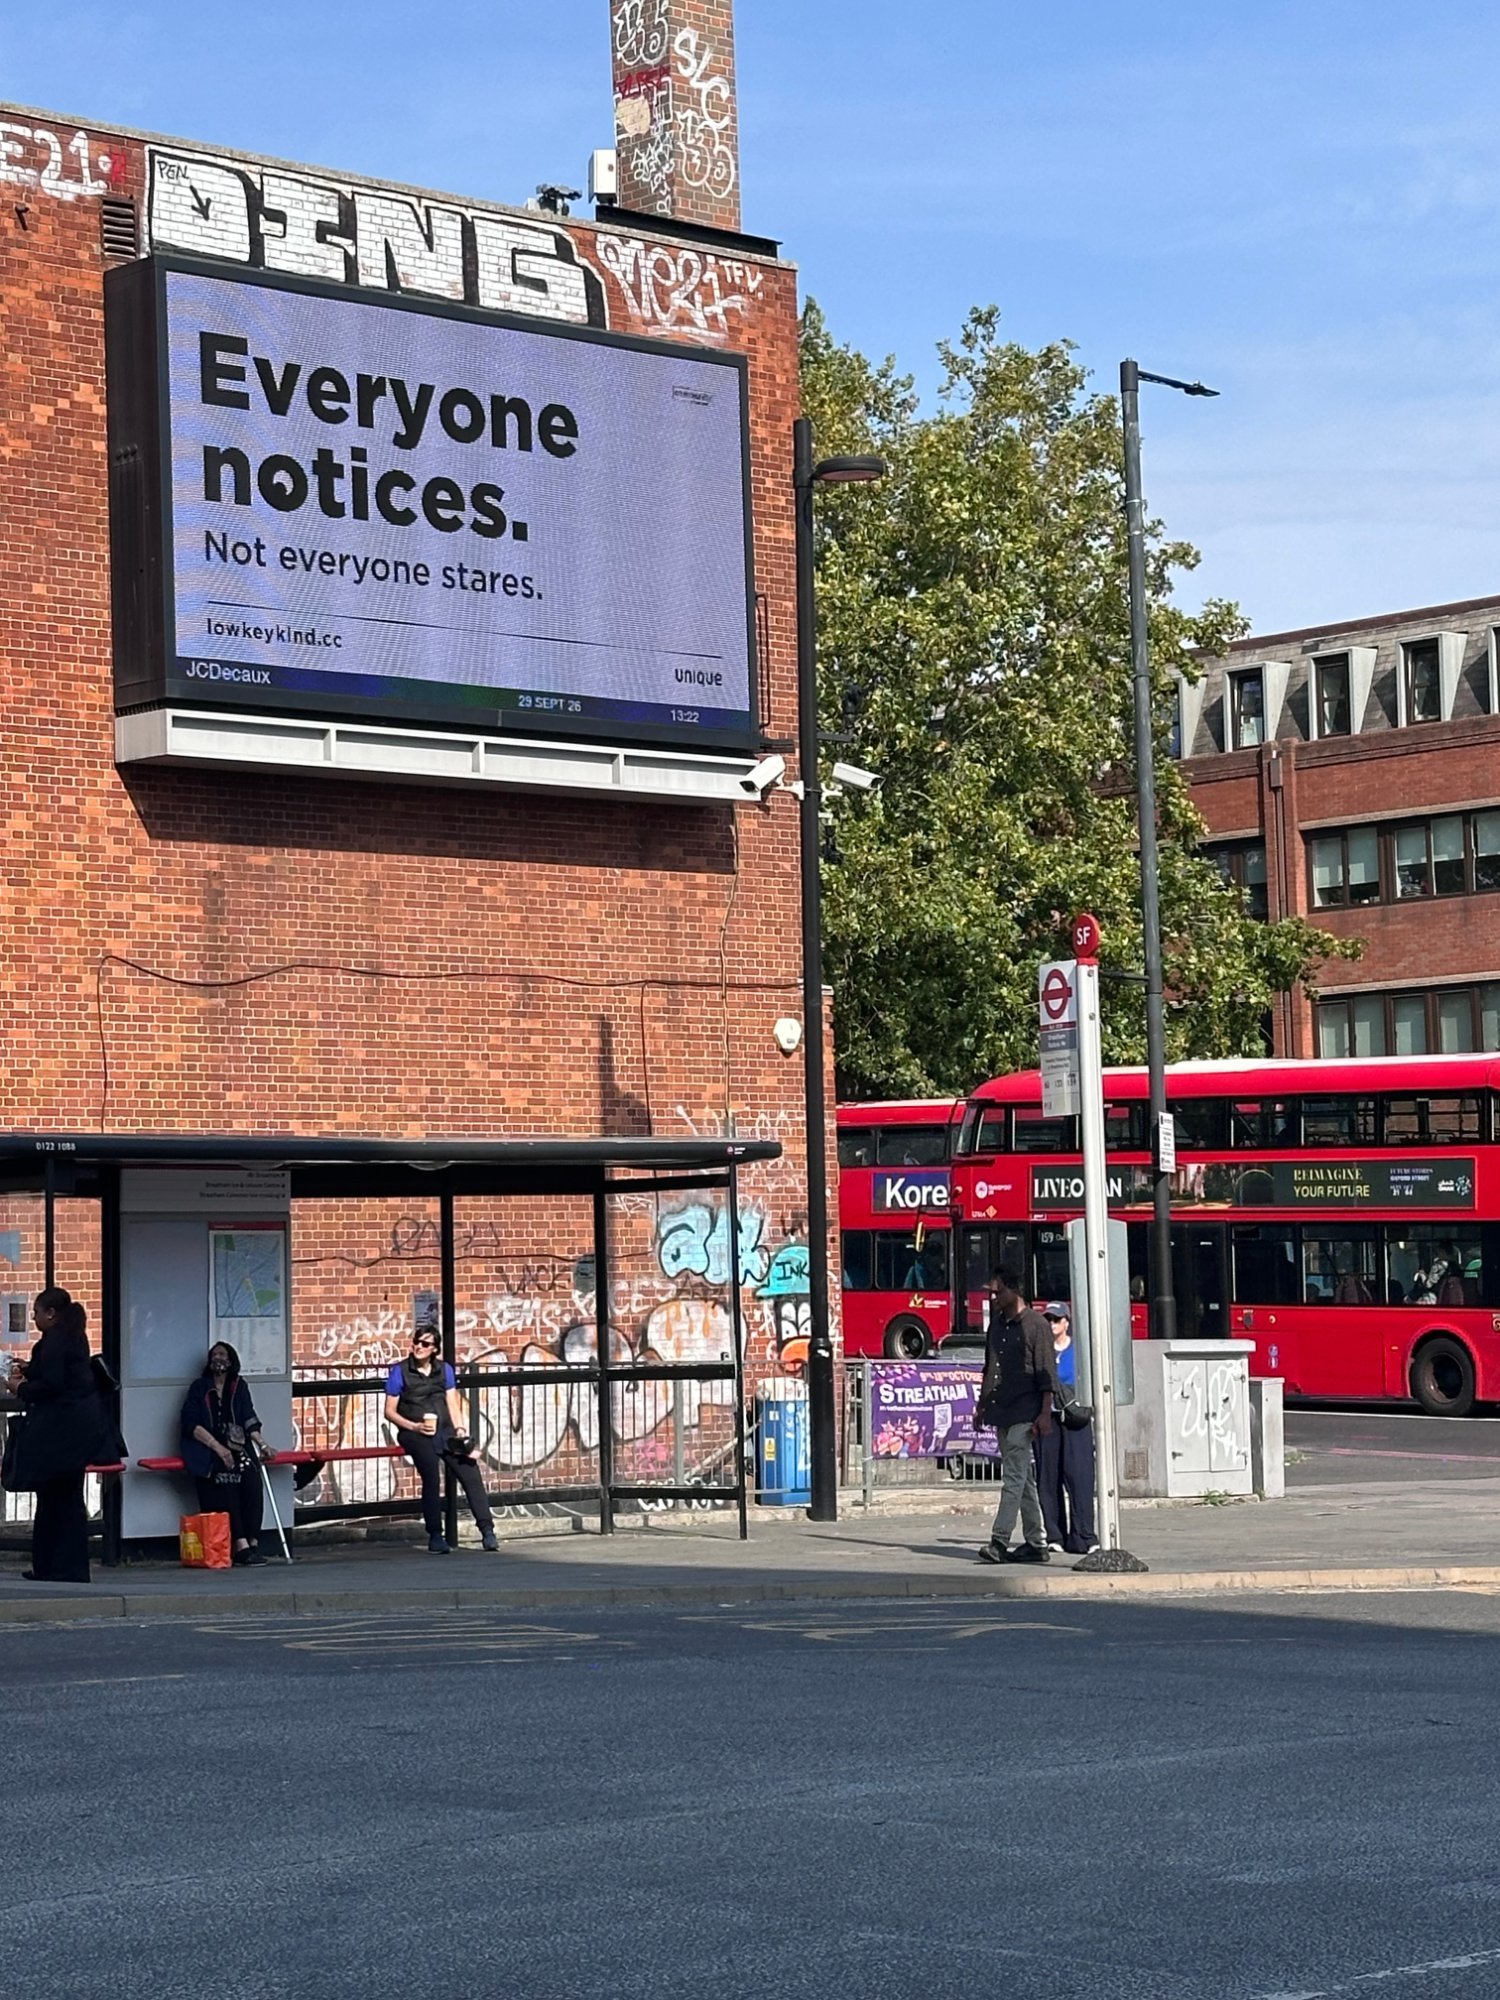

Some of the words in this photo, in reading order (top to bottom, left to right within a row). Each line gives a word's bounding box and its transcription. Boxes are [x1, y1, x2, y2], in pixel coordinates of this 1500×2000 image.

[200, 332, 579, 459] Everyone
[203, 444, 528, 542] notices.
[204, 530, 266, 568] Not
[279, 546, 430, 585] everyone
[442, 562, 543, 600] stares.
[207, 617, 342, 648] lowkeykind.cc
[186, 660, 272, 685] JCDecaux
[518, 694, 535, 708] 29
[535, 697, 564, 711] SEPT
[567, 700, 582, 713] 26
[670, 709, 699, 724] 13:22
[1076, 926, 1092, 946] SF
[1293, 1168, 1363, 1181] REIMAGINE
[1034, 1177, 1122, 1198] LIVEON
[1293, 1185, 1324, 1198] YOUR
[1326, 1184, 1370, 1198] FUTURE
[949, 1371, 984, 1383] OCTOBE
[879, 1383, 968, 1404] STREATHAM
